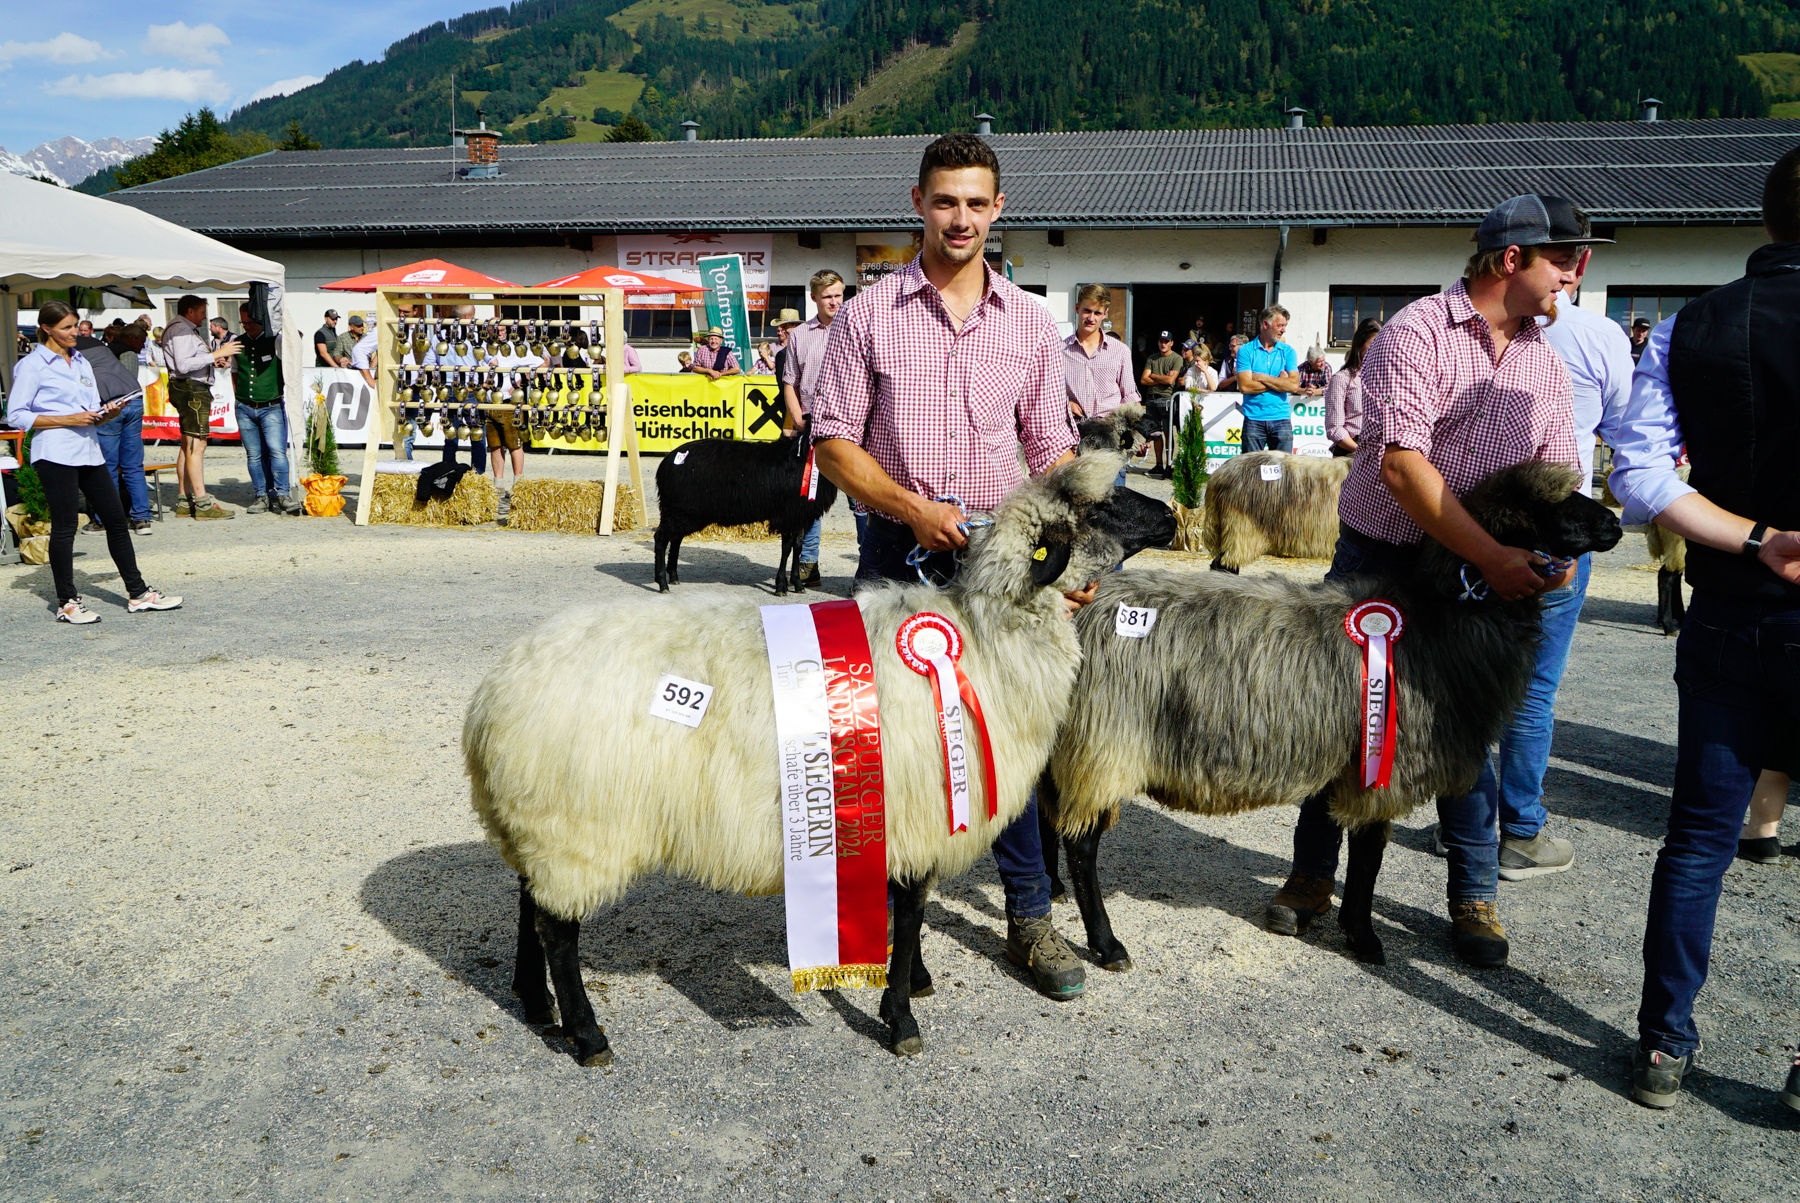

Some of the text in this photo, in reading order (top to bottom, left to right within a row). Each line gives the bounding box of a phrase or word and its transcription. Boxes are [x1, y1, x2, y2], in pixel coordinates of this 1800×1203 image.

[861, 262, 881, 271] 5760
[861, 273, 879, 281] Tel.:
[632, 398, 735, 418] eisenbank
[1293, 402, 1326, 417] Qua
[1262, 466, 1279, 474] 616
[1120, 608, 1149, 627] 581
[663, 683, 704, 710] 592
[1368, 678, 1383, 758] SIEGER
[823, 656, 862, 858] LANDESSCHAU 2024
[849, 663, 884, 847] SALZBURGER
[945, 705, 966, 797] SIEGER
[788, 784, 804, 812] über
[790, 816, 805, 824] 3
[790, 828, 806, 861] Jahre
